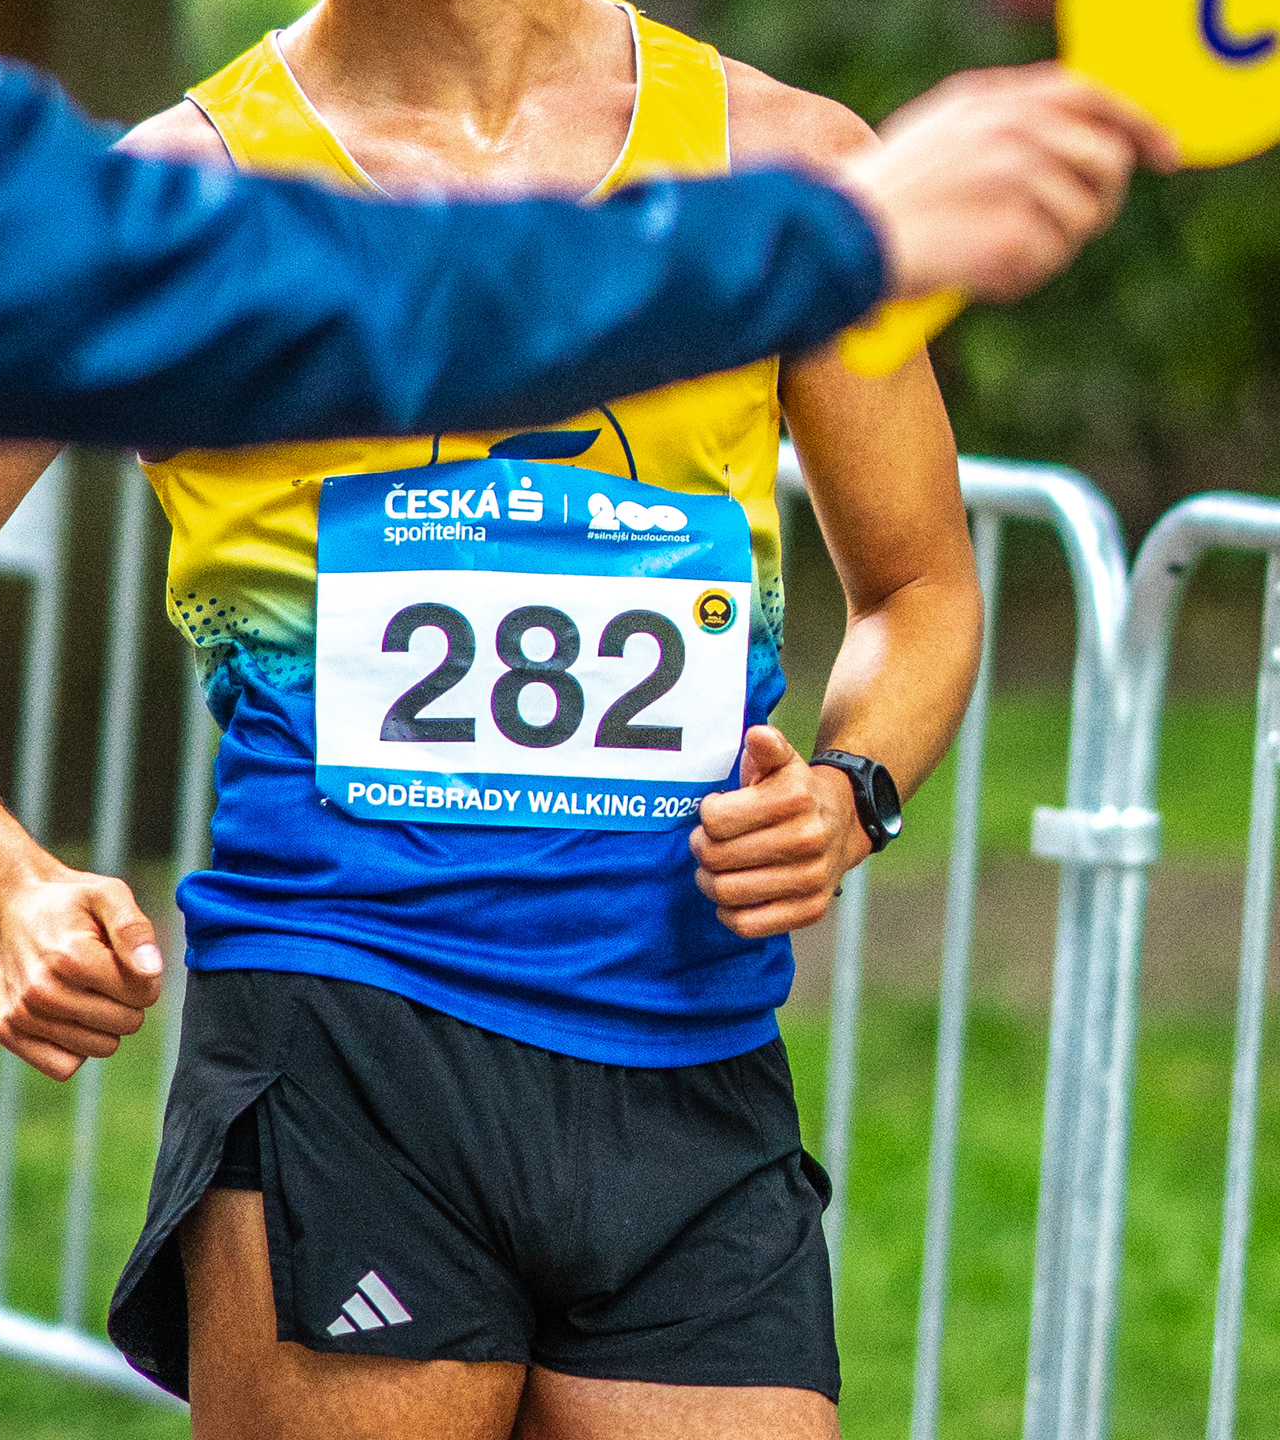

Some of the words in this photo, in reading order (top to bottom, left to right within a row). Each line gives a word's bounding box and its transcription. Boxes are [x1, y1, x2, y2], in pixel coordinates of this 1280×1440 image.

[384, 482, 501, 520] ČESKÁ
[383, 521, 487, 546] spořitelna
[630, 533, 690, 543] budoucnost
[379, 601, 686, 752] 282
[347, 779, 522, 812] PODĚBRADY
[527, 790, 647, 818] WALKING
[651, 796, 702, 818] 2025
